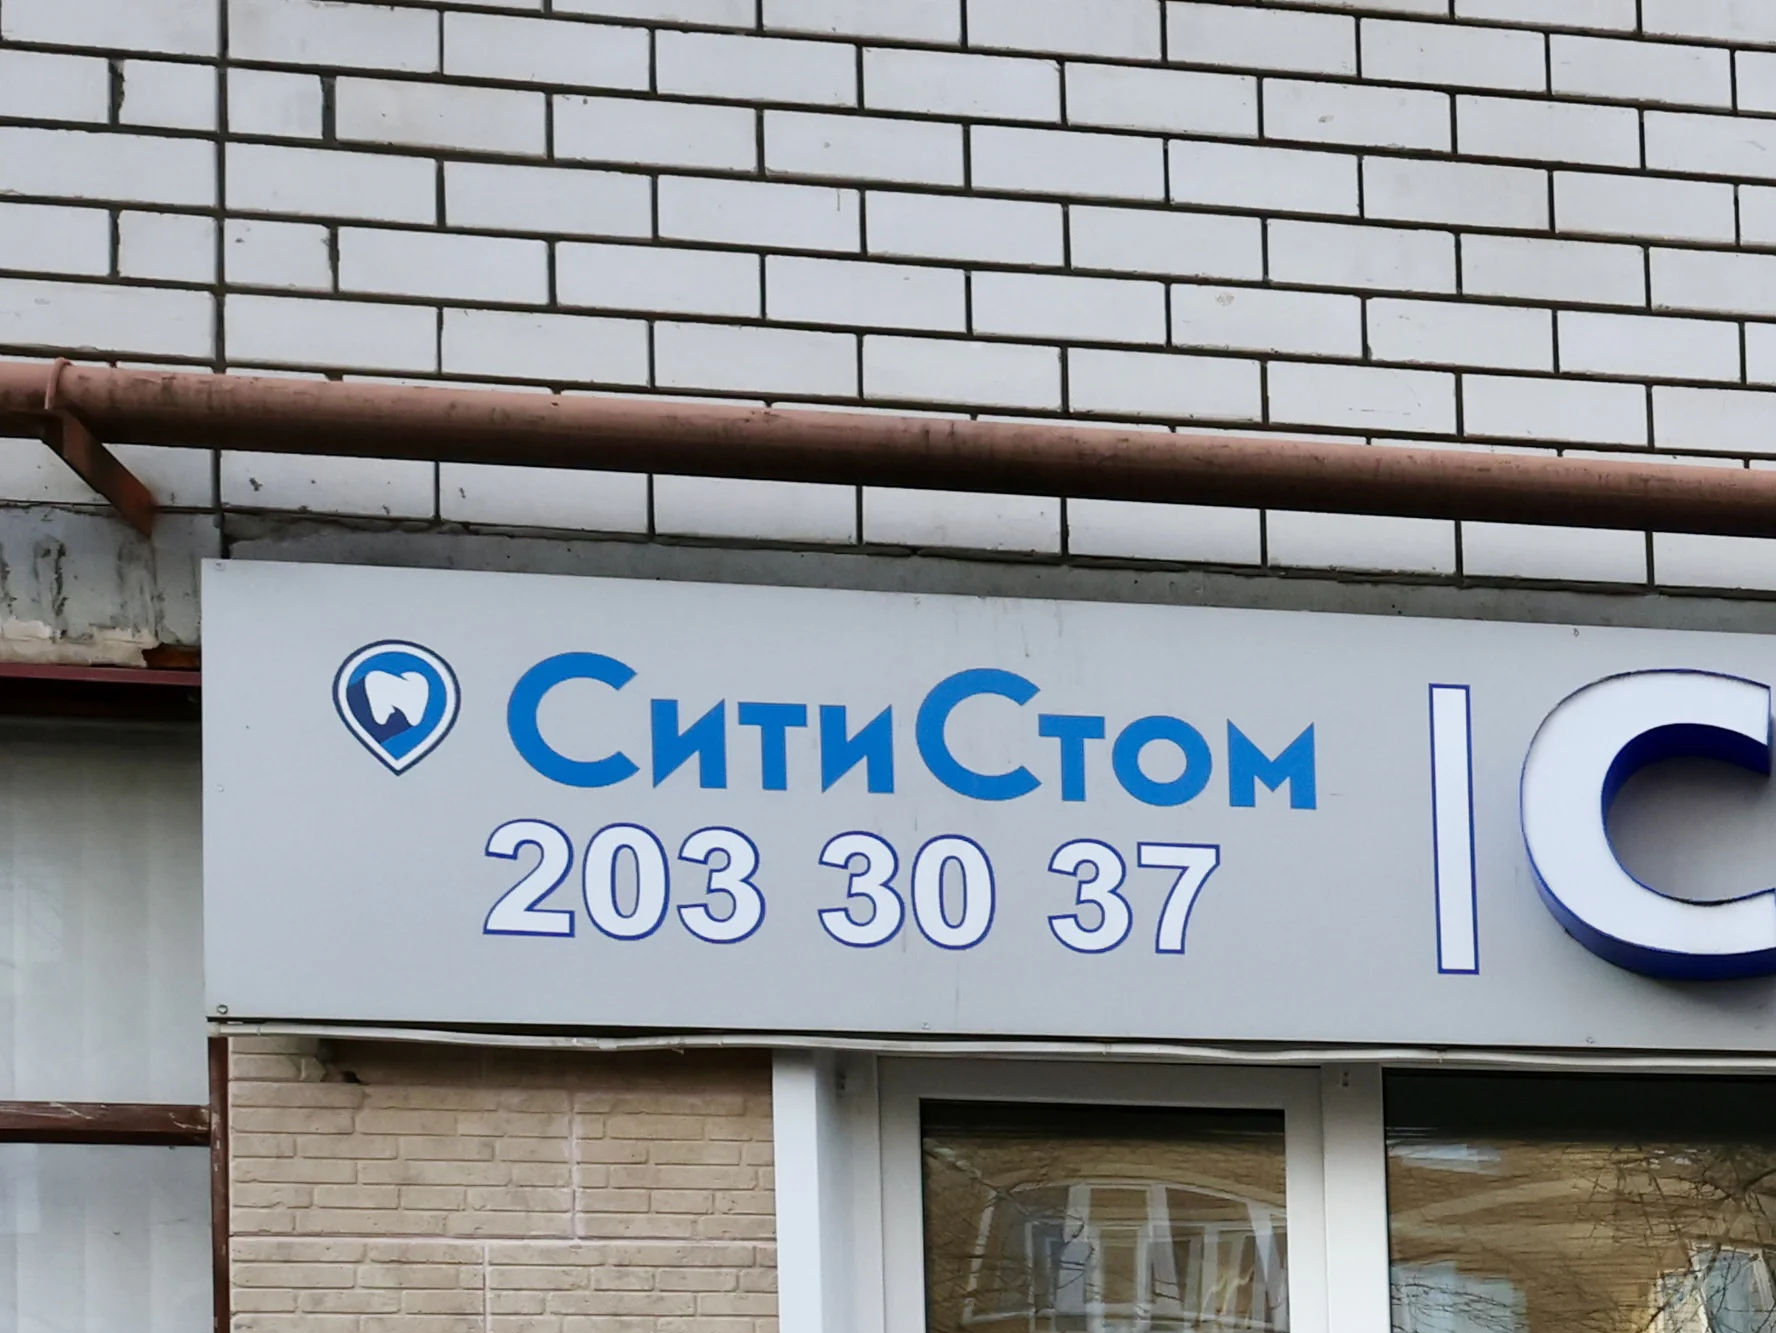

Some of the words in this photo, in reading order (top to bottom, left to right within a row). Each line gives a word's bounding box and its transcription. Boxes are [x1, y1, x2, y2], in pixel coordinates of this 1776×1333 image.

[506, 650, 1318, 811] СитиСтом
[482, 817, 767, 945] 203
[817, 830, 997, 951] 30
[1045, 837, 1221, 956] 37
